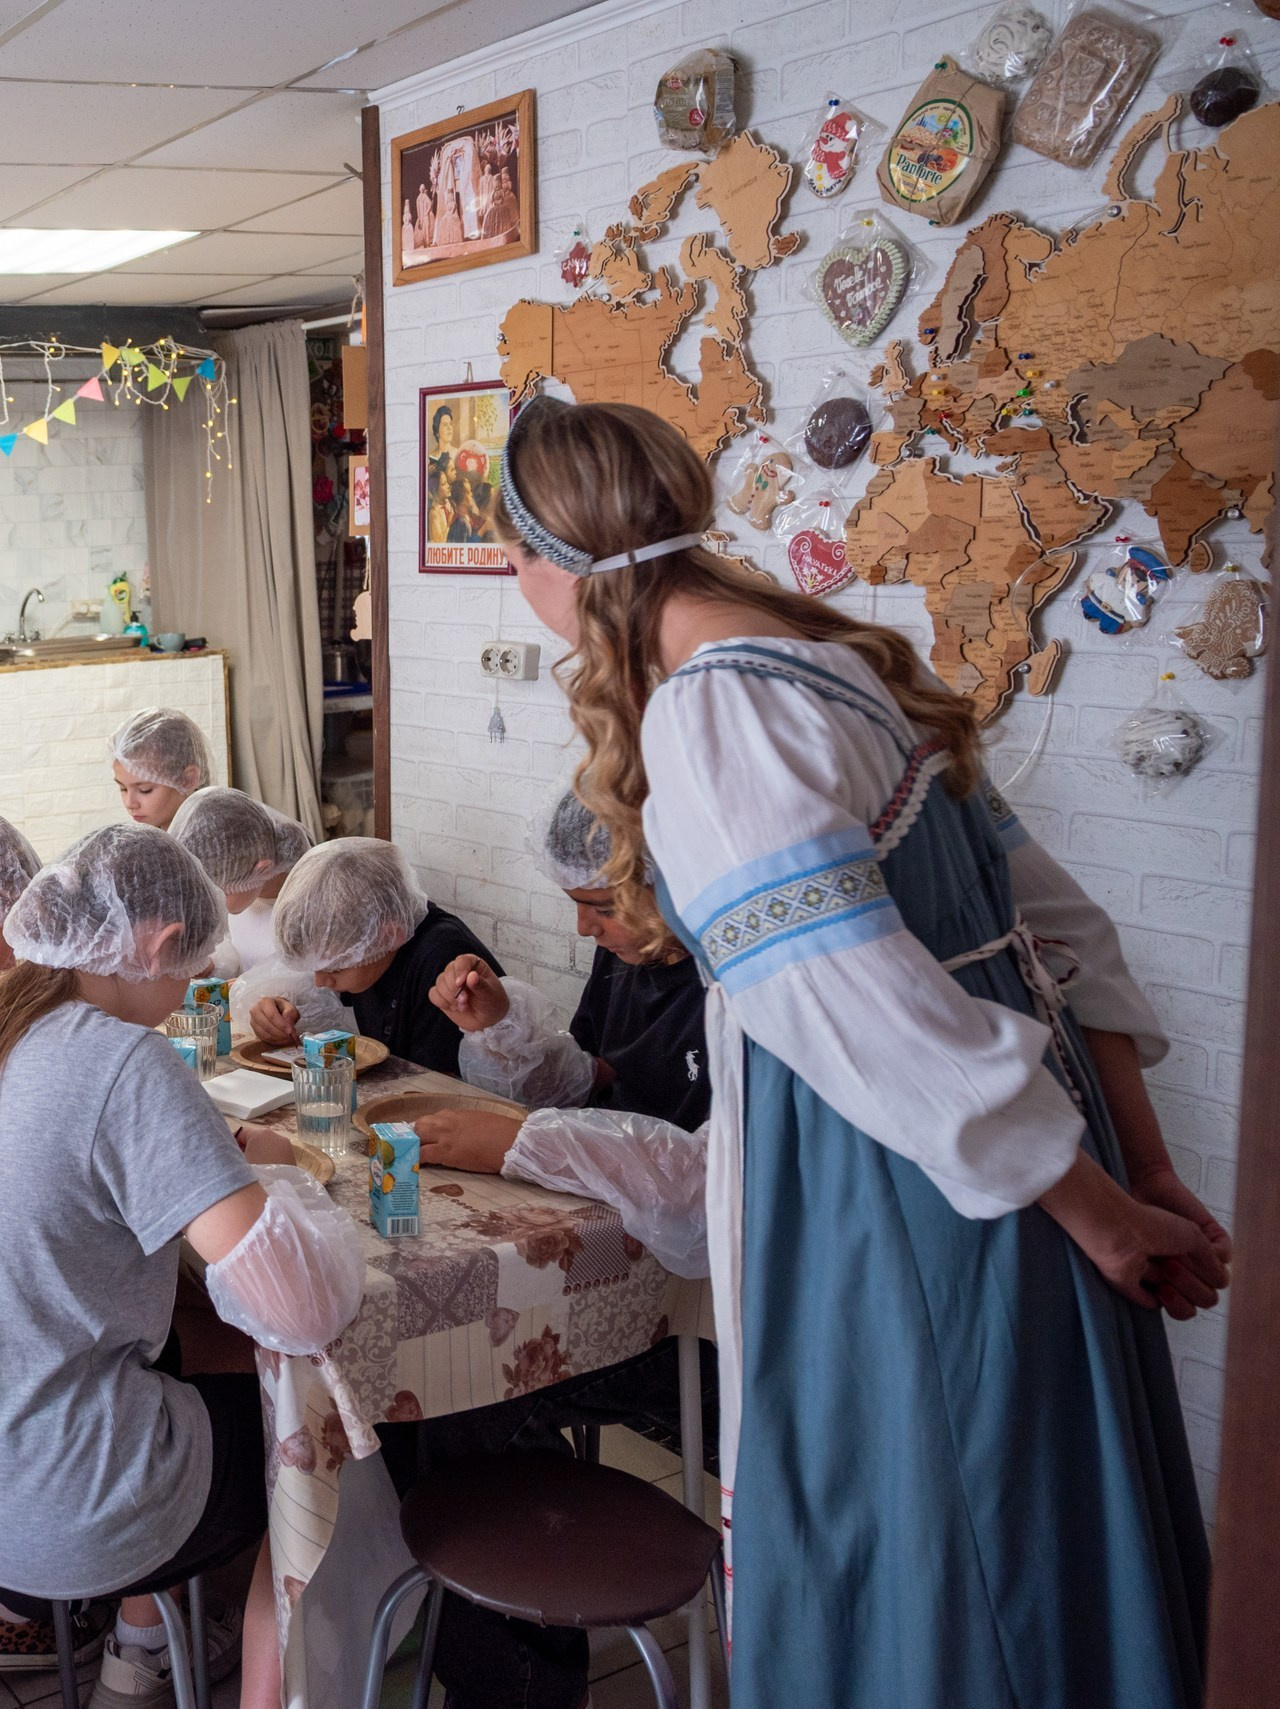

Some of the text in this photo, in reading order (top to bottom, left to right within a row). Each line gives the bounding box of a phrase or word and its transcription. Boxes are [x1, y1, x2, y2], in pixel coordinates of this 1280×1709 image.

[896, 153, 943, 185] Panforte
[1118, 377, 1169, 391] Казахстан
[426, 547, 507, 566] ЛЮБИТЕ РОДИНУ
